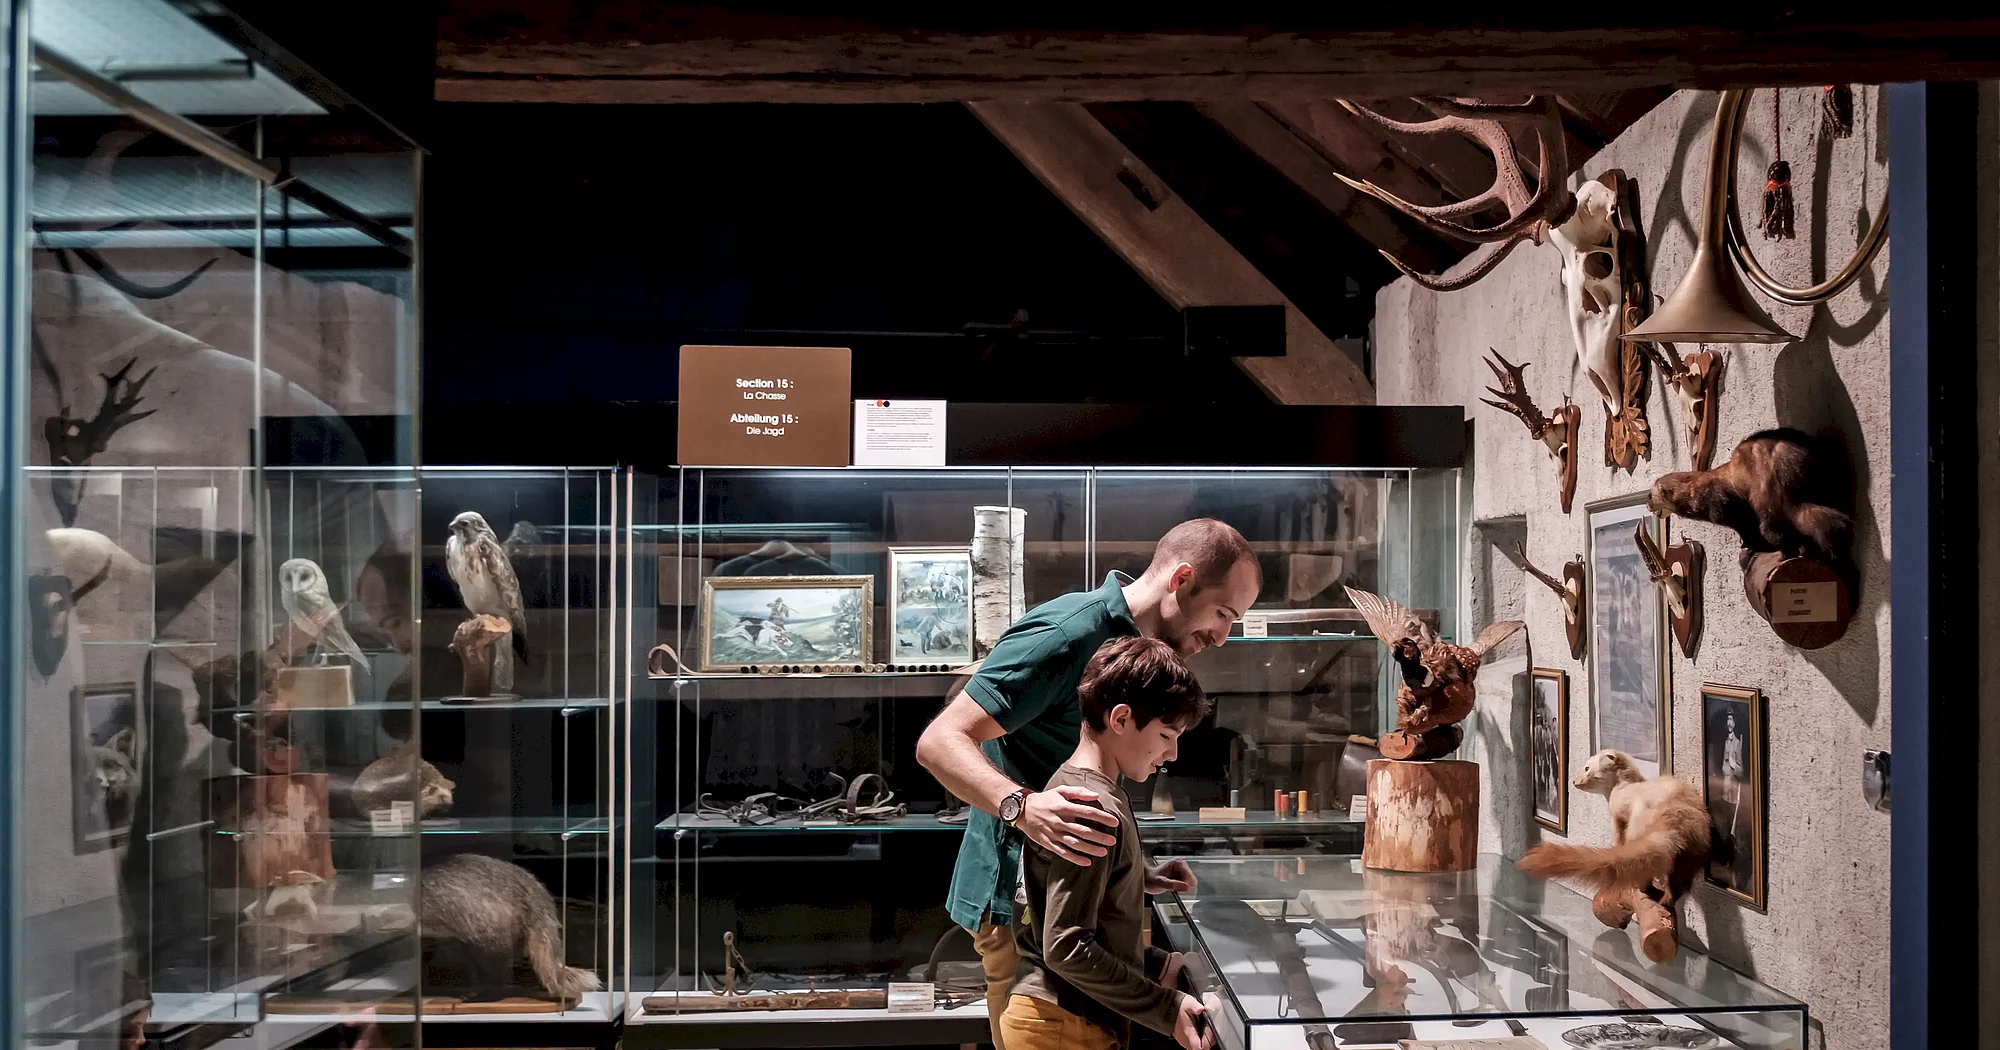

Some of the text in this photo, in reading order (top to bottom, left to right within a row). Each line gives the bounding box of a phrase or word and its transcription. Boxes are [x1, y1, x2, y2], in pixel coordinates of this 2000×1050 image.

[736, 378, 774, 389] Section
[743, 391, 787, 401] La Chasse
[730, 413, 779, 425] Abteilung
[746, 426, 785, 437] Die Jagd
